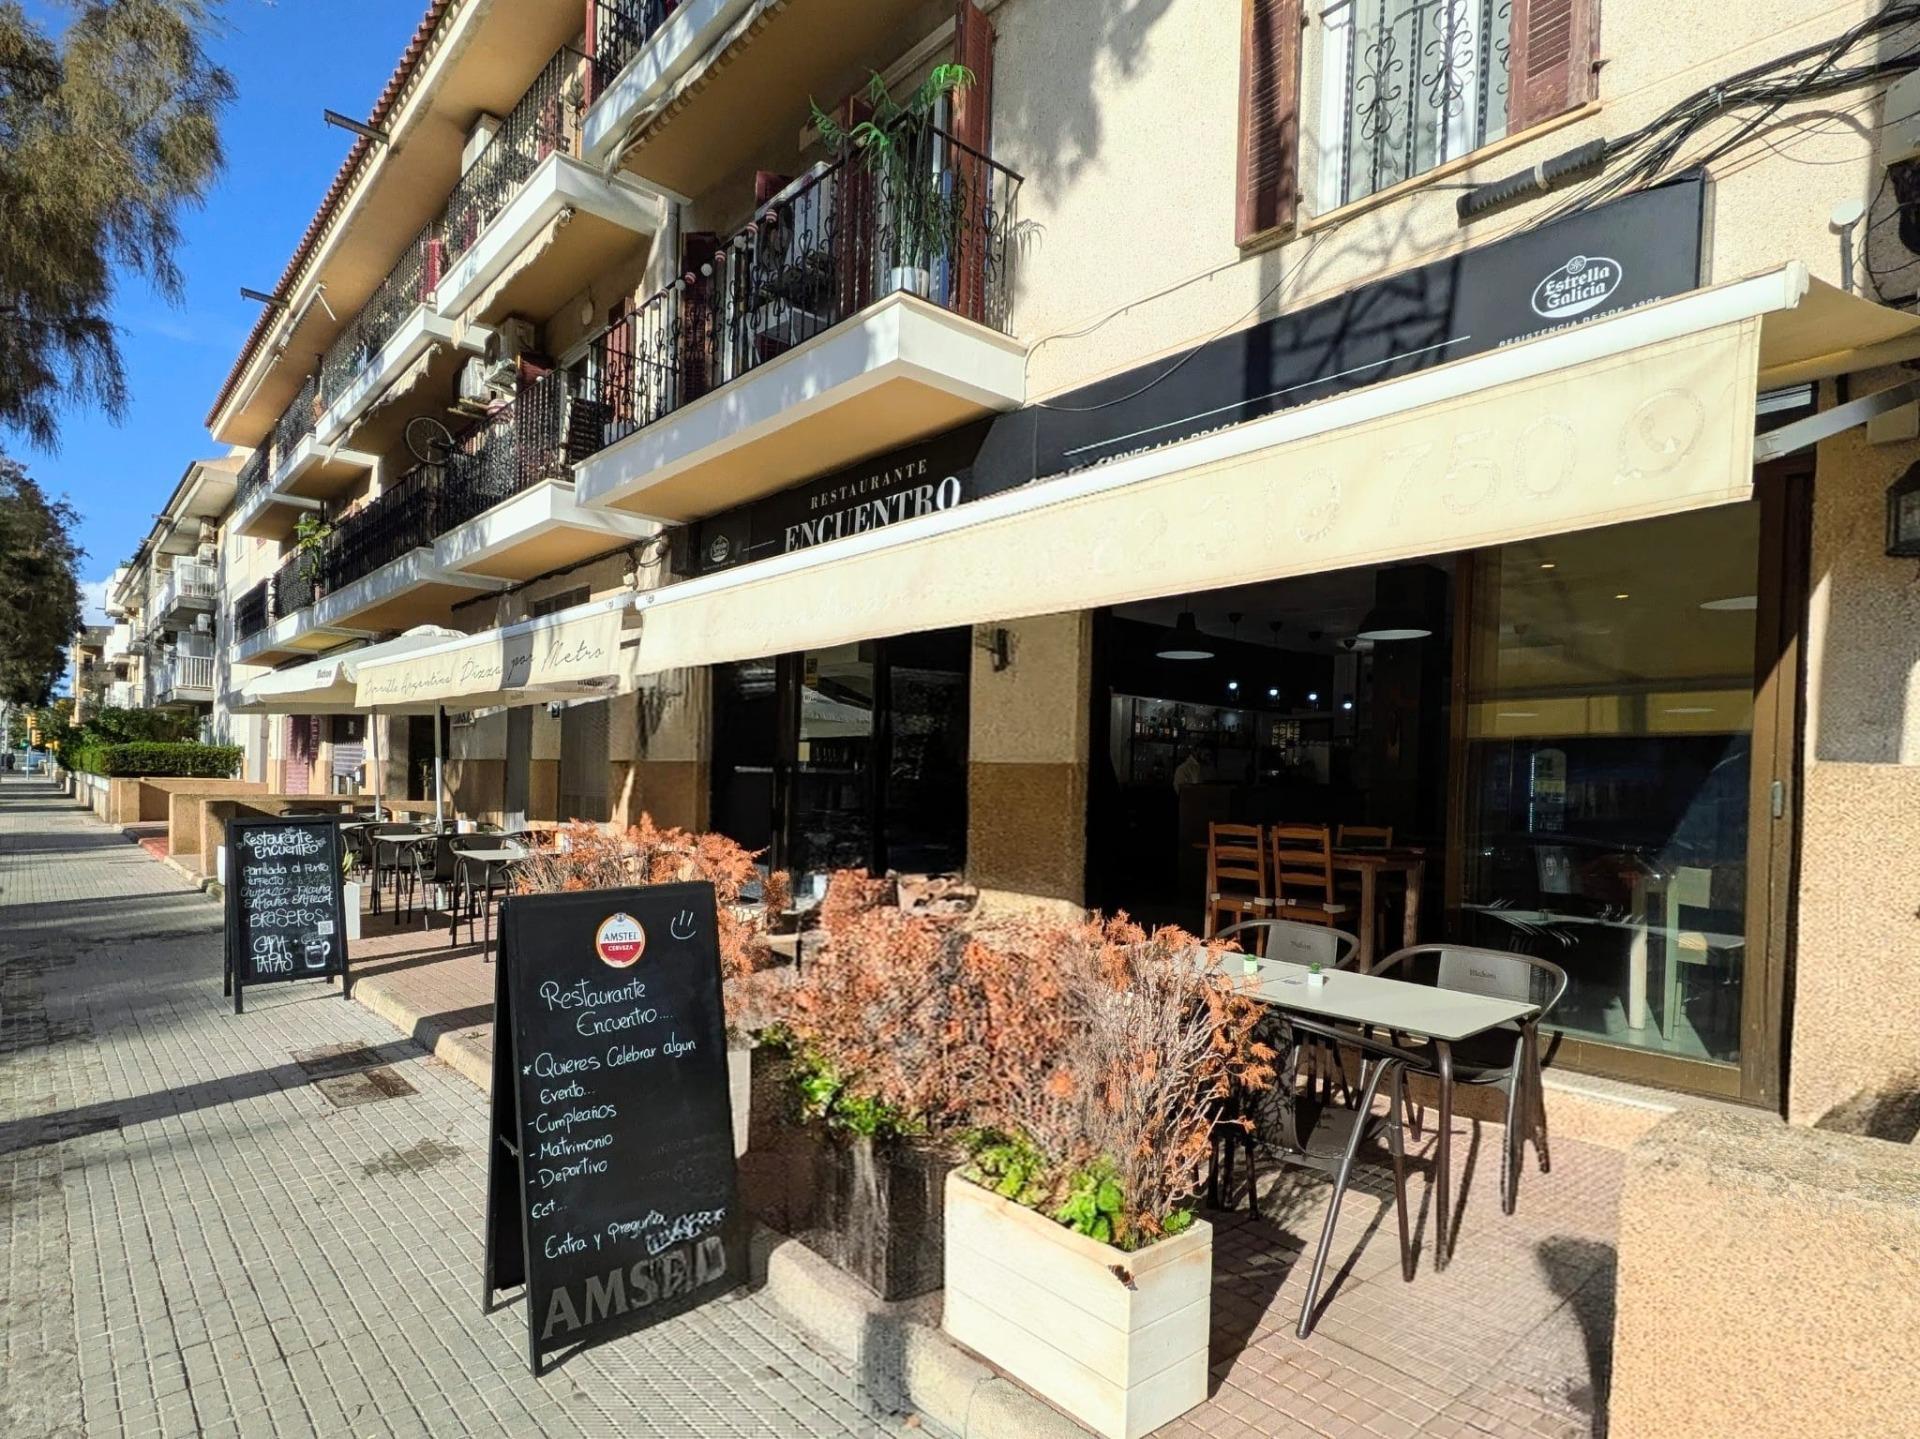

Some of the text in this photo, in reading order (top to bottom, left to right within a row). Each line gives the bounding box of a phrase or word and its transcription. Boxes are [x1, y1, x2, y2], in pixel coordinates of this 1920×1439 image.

[1544, 265, 1610, 296] Estrella
[1547, 282, 1606, 308] Galicia
[1499, 320, 1577, 347] RESISTENCIA
[810, 459, 927, 509] RESTAURANTE
[785, 476, 961, 553] ENCUENTRO
[541, 640, 605, 672] Metro
[603, 931, 639, 942] AMSTEL
[539, 977, 646, 1010] Restaurante
[535, 1052, 600, 1079] Quieres
[607, 1046, 656, 1068] Celebrar
[545, 1234, 587, 1259] Entra
